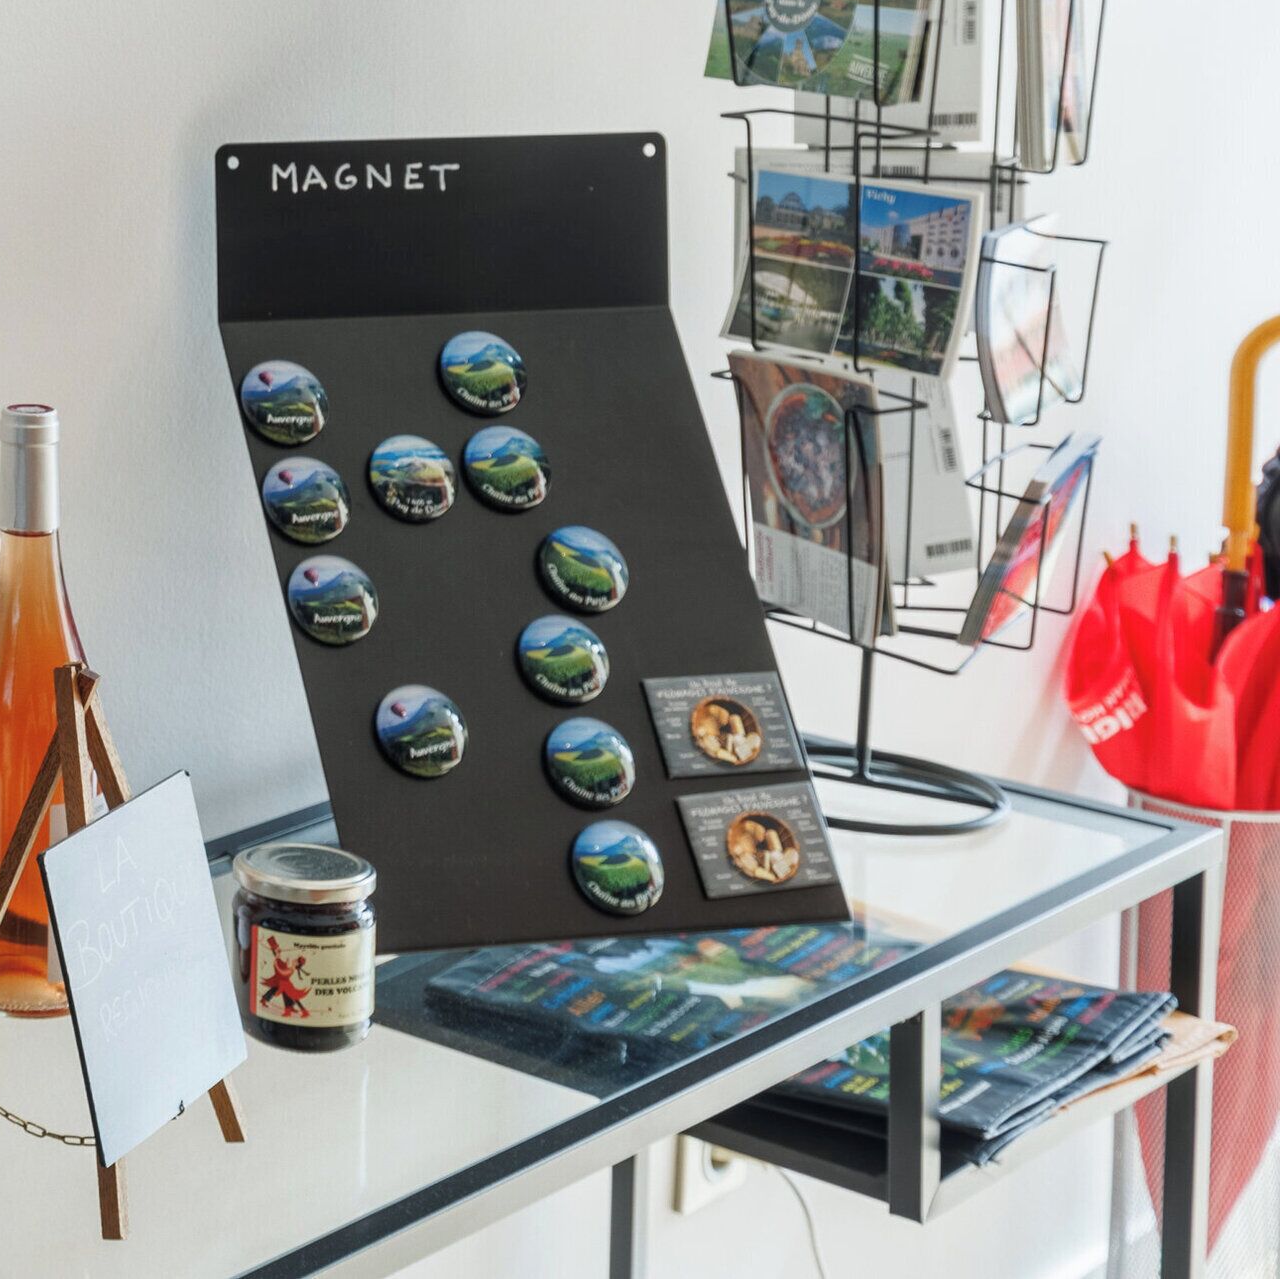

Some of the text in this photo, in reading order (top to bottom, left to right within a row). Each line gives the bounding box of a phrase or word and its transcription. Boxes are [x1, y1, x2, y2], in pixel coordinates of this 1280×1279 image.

[272, 162, 460, 194] MAGNET
[96, 834, 138, 894] LA
[67, 877, 191, 992] BOUTIQU
[311, 977, 347, 985] PERLES
